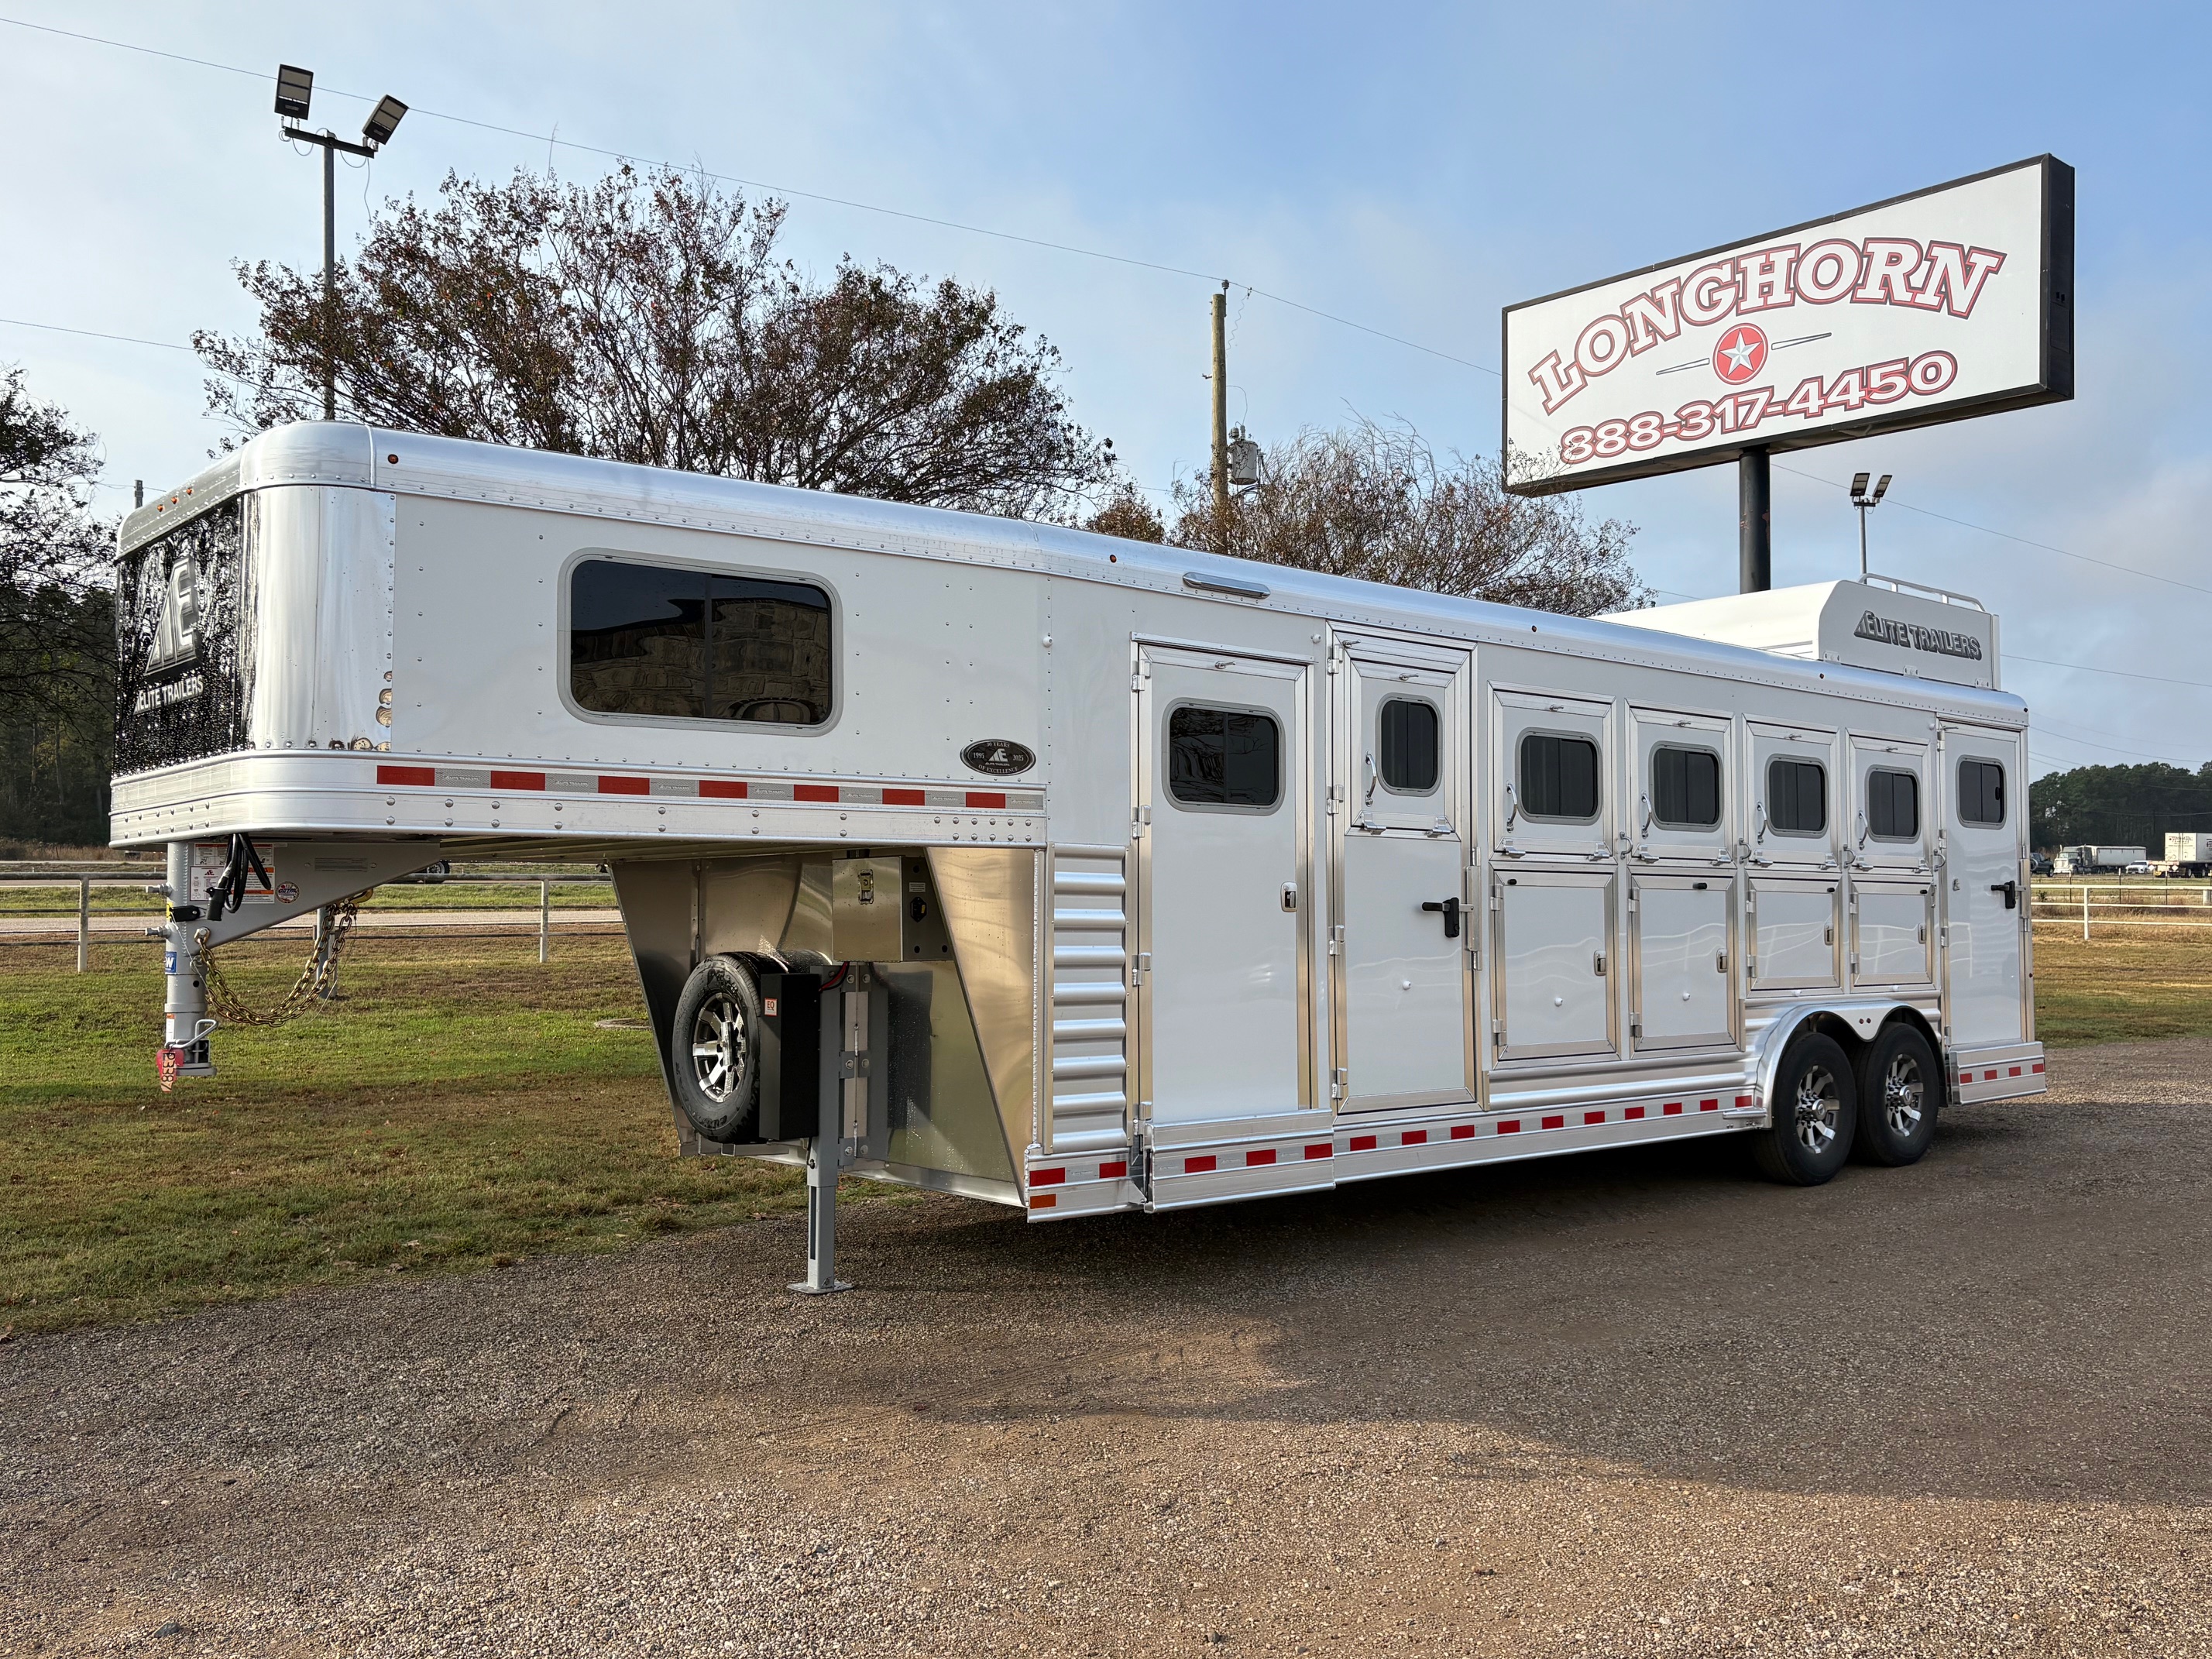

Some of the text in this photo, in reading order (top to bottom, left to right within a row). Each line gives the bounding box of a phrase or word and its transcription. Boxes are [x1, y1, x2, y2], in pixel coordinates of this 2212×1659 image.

[1528, 237, 2008, 416] LONGHORN
[1560, 350, 1958, 464] 888-317-4450
[1908, 623, 1983, 661] TRAILERS
[161, 674, 204, 706] TRAILERS
